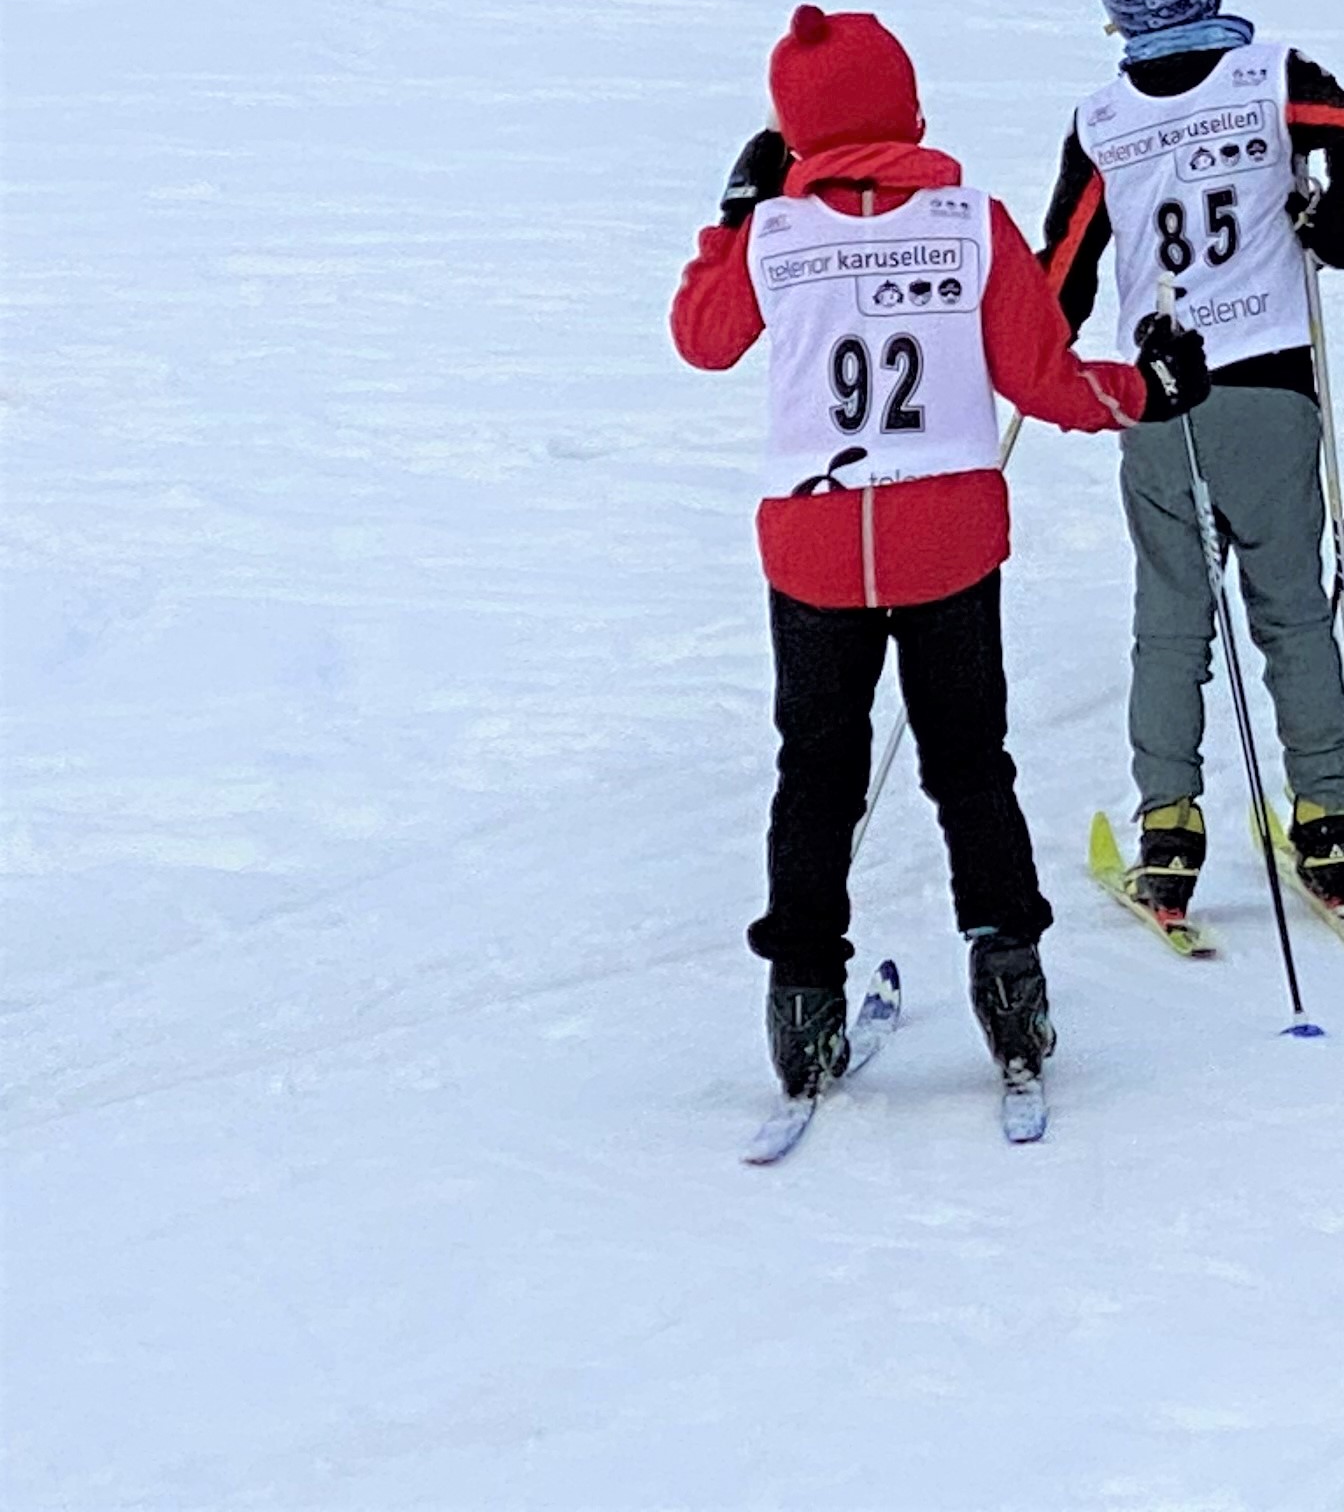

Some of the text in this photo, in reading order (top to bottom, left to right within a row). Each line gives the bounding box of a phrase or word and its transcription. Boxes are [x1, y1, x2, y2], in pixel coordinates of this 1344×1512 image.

[836, 245, 957, 272] karusellen
[1154, 184, 1240, 275] 85
[1188, 291, 1270, 329] telenor
[828, 333, 926, 434] 92
